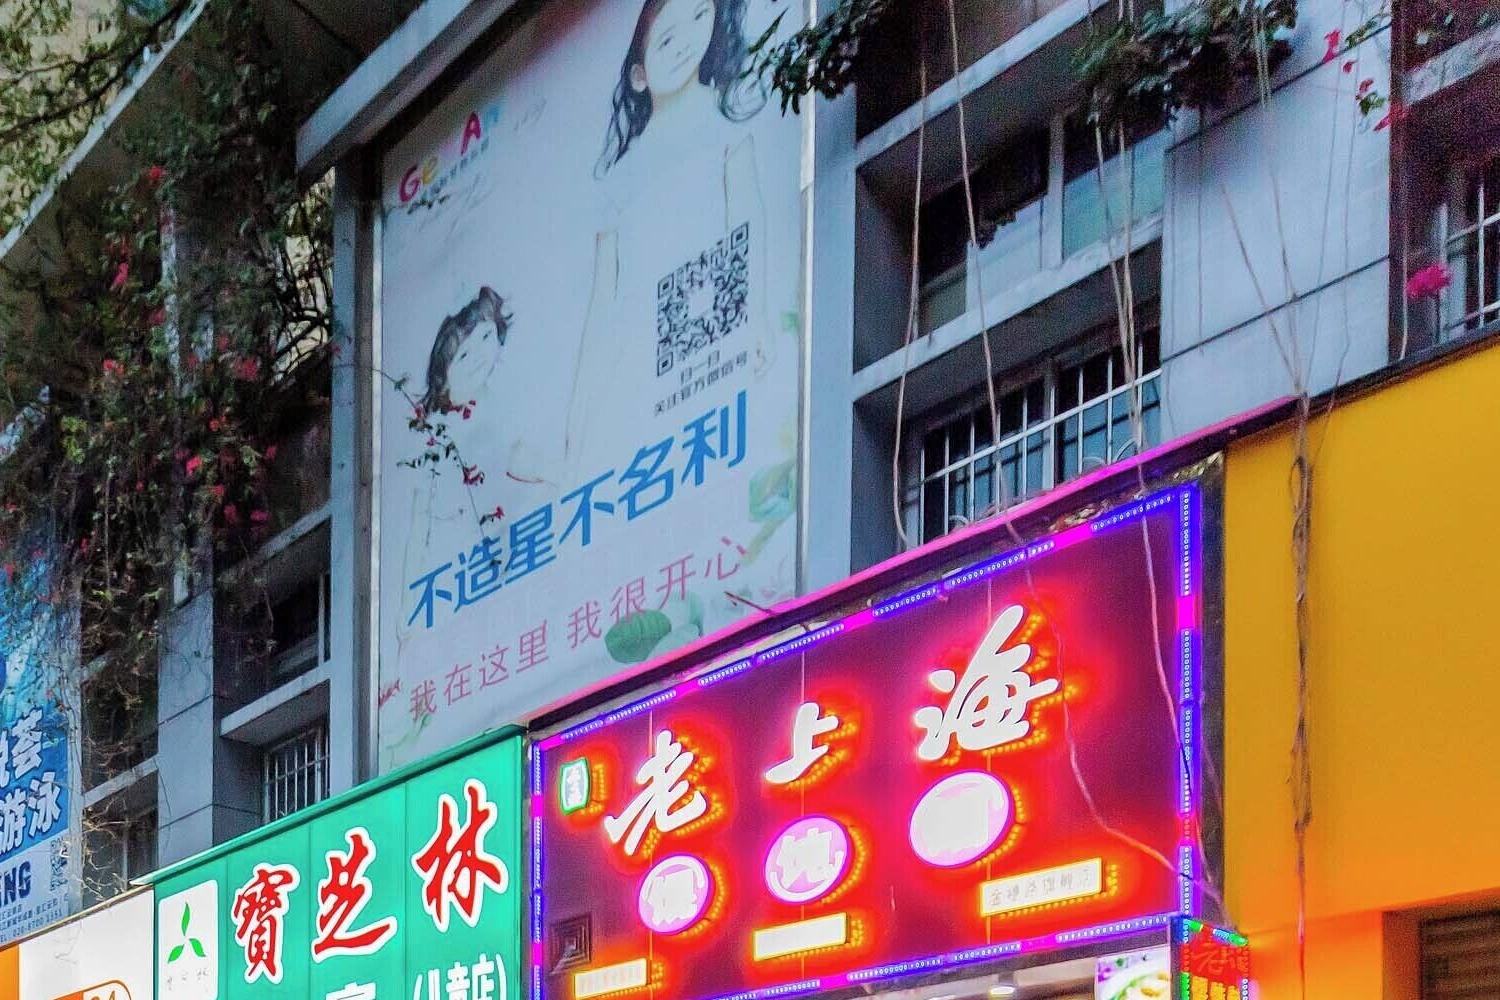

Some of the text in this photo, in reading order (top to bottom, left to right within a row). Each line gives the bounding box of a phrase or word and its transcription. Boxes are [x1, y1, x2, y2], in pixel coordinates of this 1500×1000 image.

[407, 389, 747, 629] 不造星不名利
[409, 535, 748, 722] 我在这里 我很开心
[603, 604, 1059, 856] 老上海
